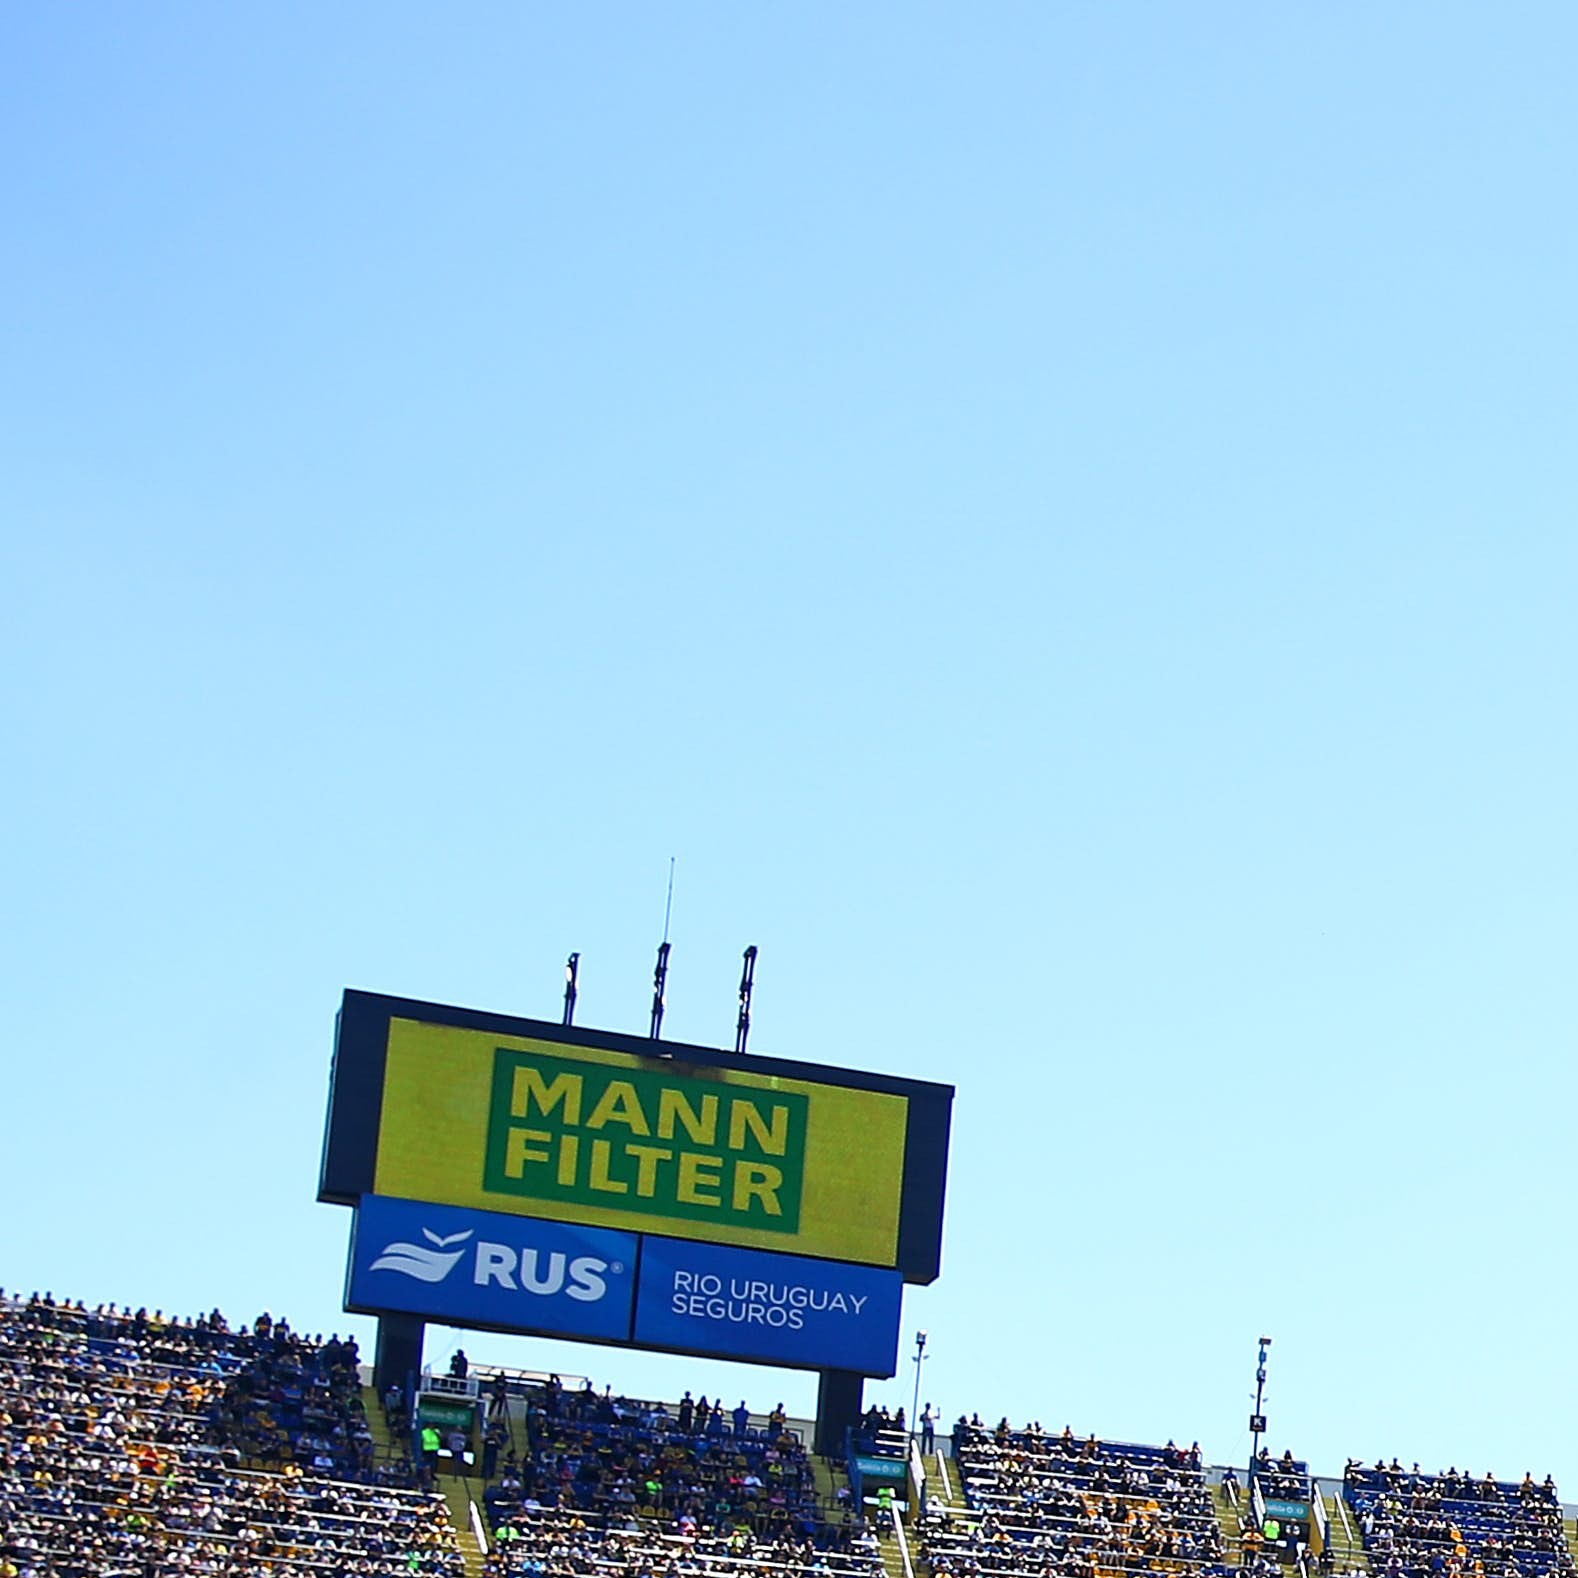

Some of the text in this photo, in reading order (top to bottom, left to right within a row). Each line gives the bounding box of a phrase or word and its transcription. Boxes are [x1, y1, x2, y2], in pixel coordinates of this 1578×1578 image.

[510, 1065, 789, 1156] MANN
[504, 1126, 784, 1217] FILTER
[473, 1240, 608, 1301] RUS
[673, 1271, 868, 1316] RIO URUGUAY
[671, 1293, 804, 1330] SEGUROS
